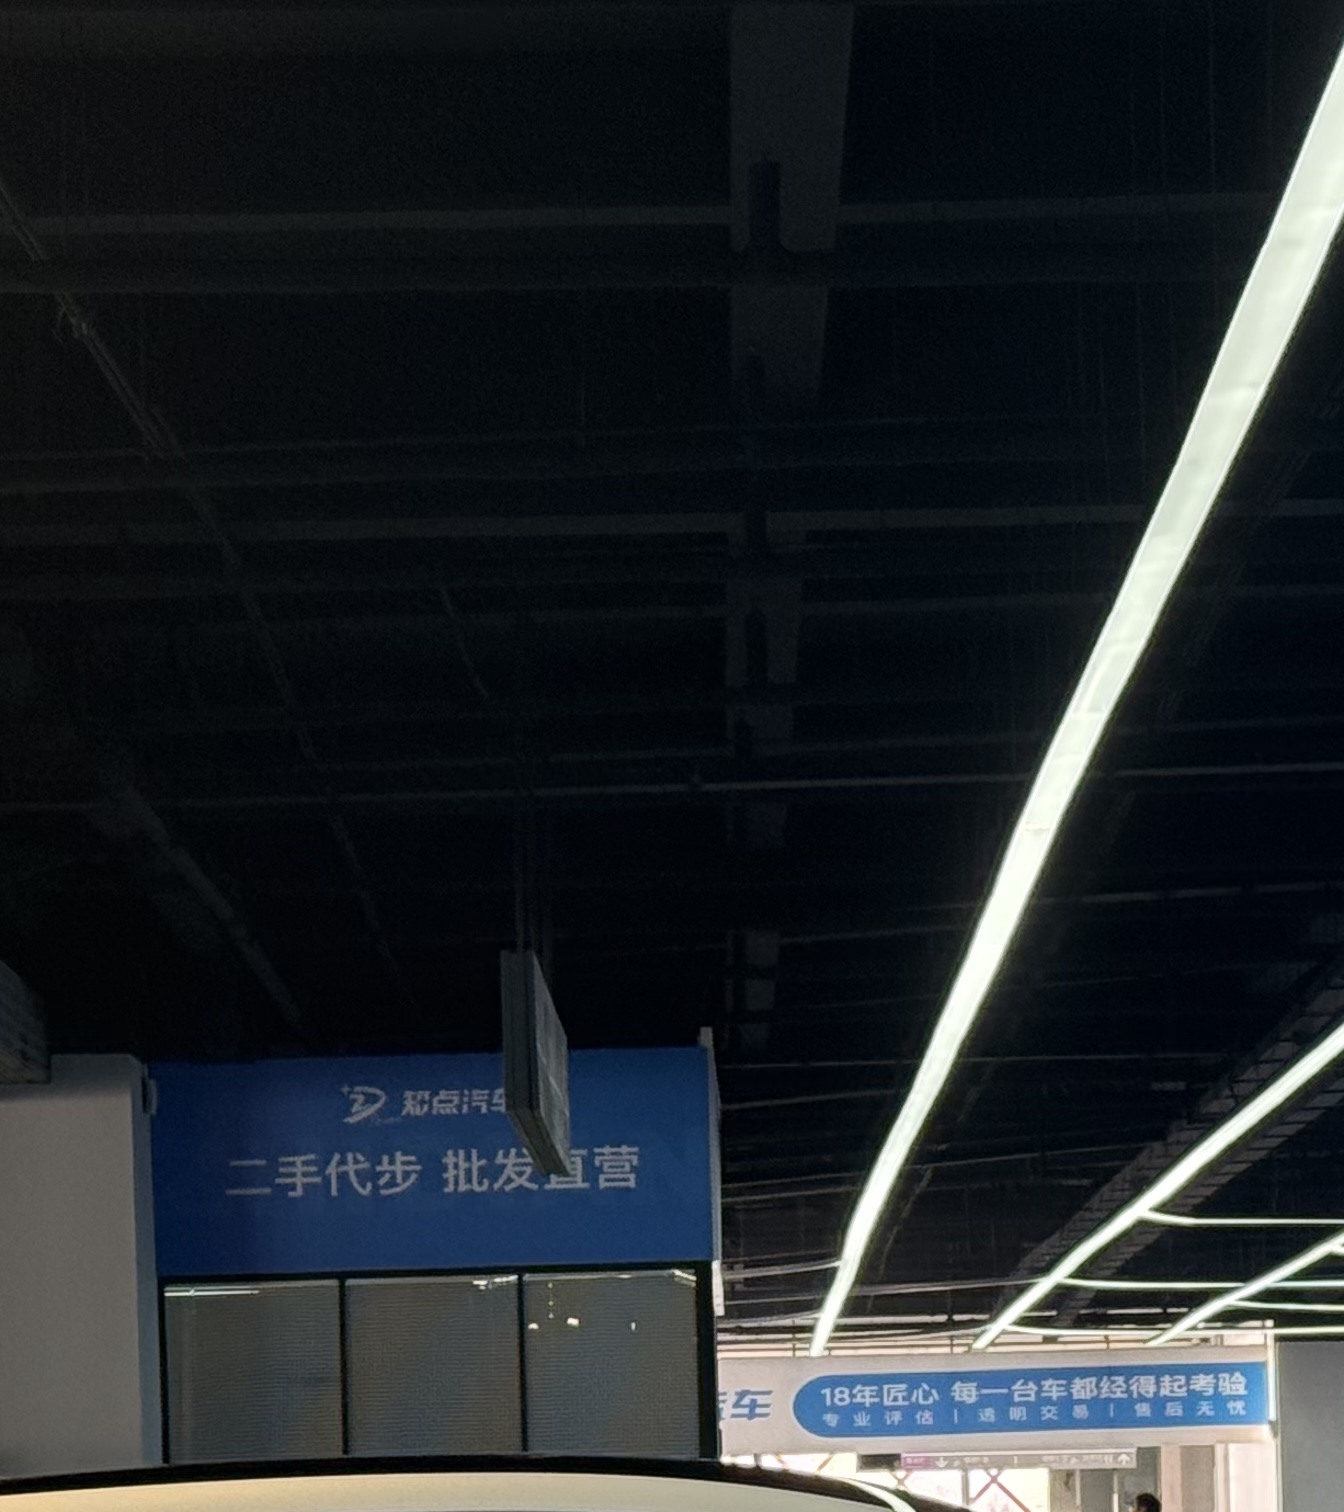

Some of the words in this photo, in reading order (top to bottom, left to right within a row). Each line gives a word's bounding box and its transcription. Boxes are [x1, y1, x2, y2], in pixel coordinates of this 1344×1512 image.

[225, 1150, 422, 1198] 二手代步
[442, 1144, 640, 1193] 批发直营
[719, 1389, 773, 1421] 车
[820, 1382, 940, 1408] 18年匠心
[950, 1371, 1249, 1405] 每一台车都经得起考验
[822, 1410, 935, 1428] 专业评估
[977, 1405, 1089, 1423] 透明交易
[1134, 1400, 1248, 1419] 售后无忧
